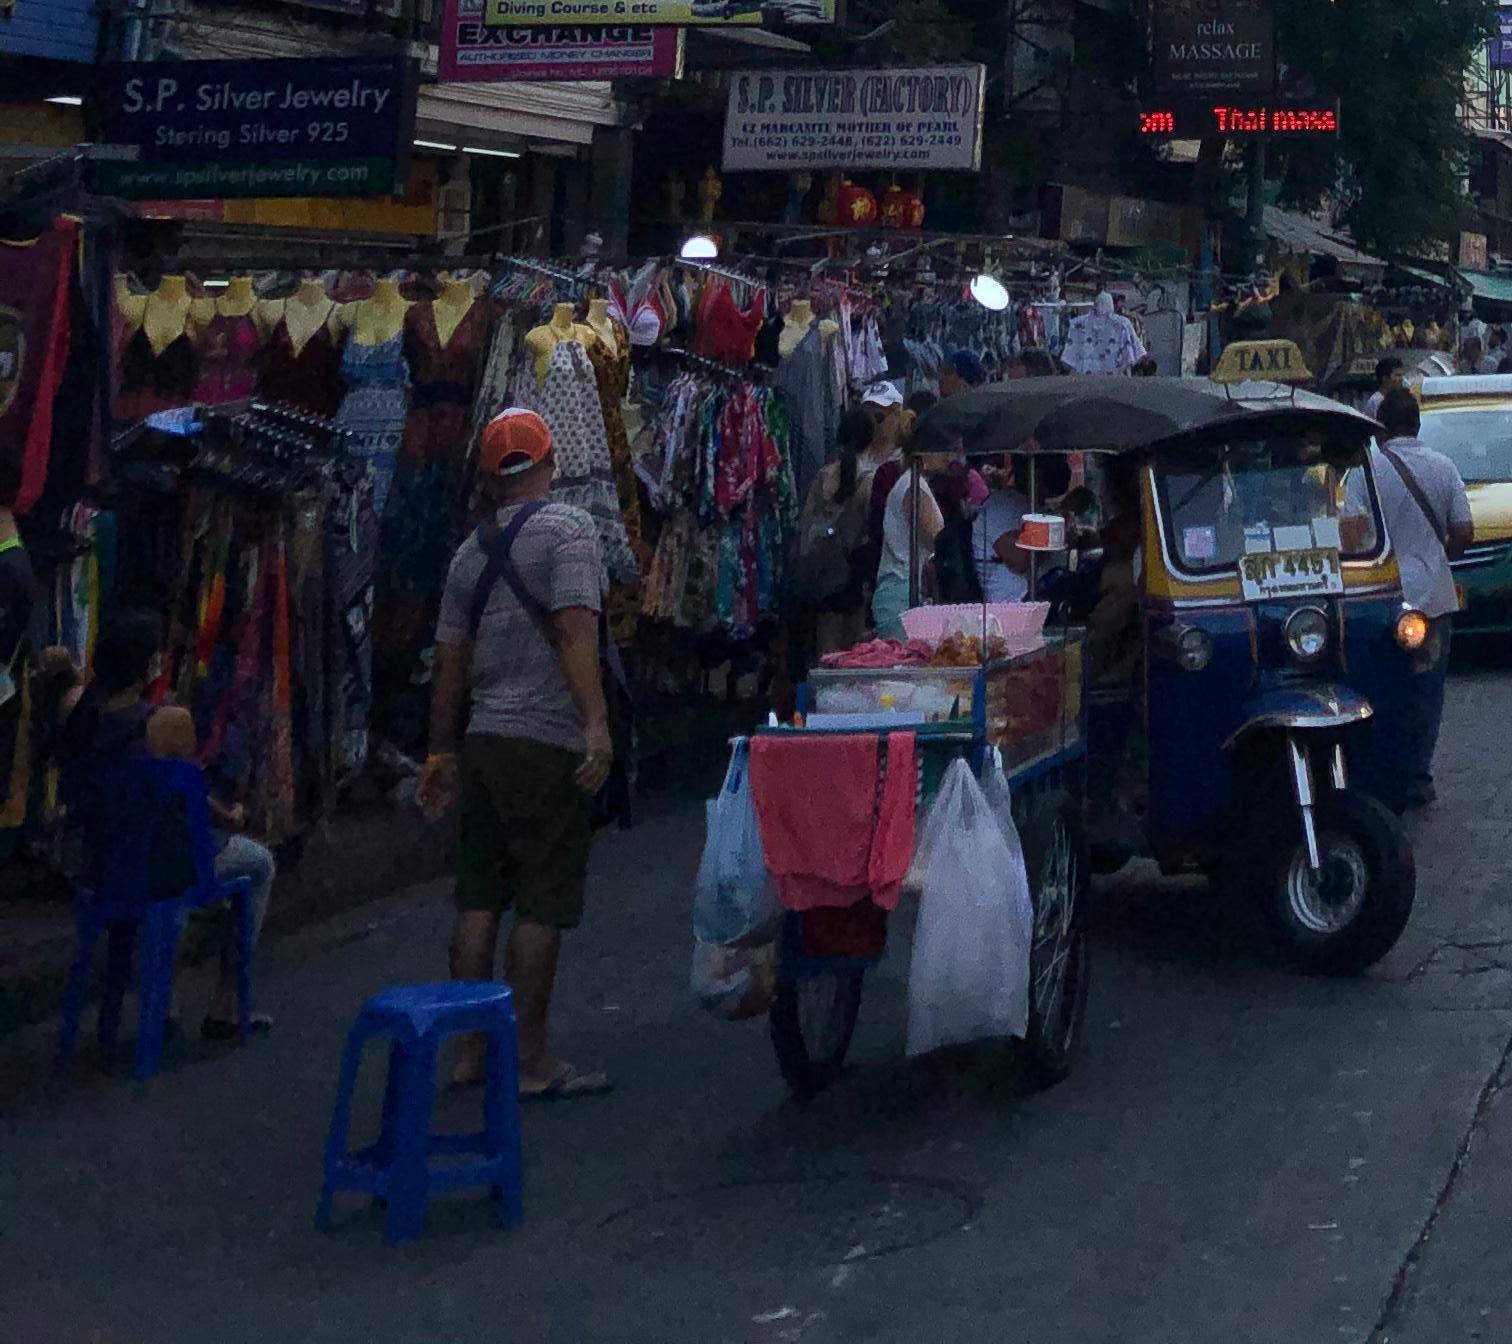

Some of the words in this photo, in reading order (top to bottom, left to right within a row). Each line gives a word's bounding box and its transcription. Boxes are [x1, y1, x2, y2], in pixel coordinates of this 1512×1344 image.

[497, 1, 545, 17] Diving
[550, 1, 609, 15] Course
[631, 2, 658, 14] etc
[1196, 18, 1235, 36] relax
[1168, 42, 1263, 61] MASSAGE
[121, 77, 186, 114] S.P.
[195, 80, 277, 112] Silver
[280, 79, 391, 115] Jewelry
[782, 74, 858, 113] SILVER
[860, 73, 973, 117] (FACTORY)
[239, 123, 300, 145] Silver
[306, 121, 349, 143] 925
[1237, 347, 1292, 371] TAXI
